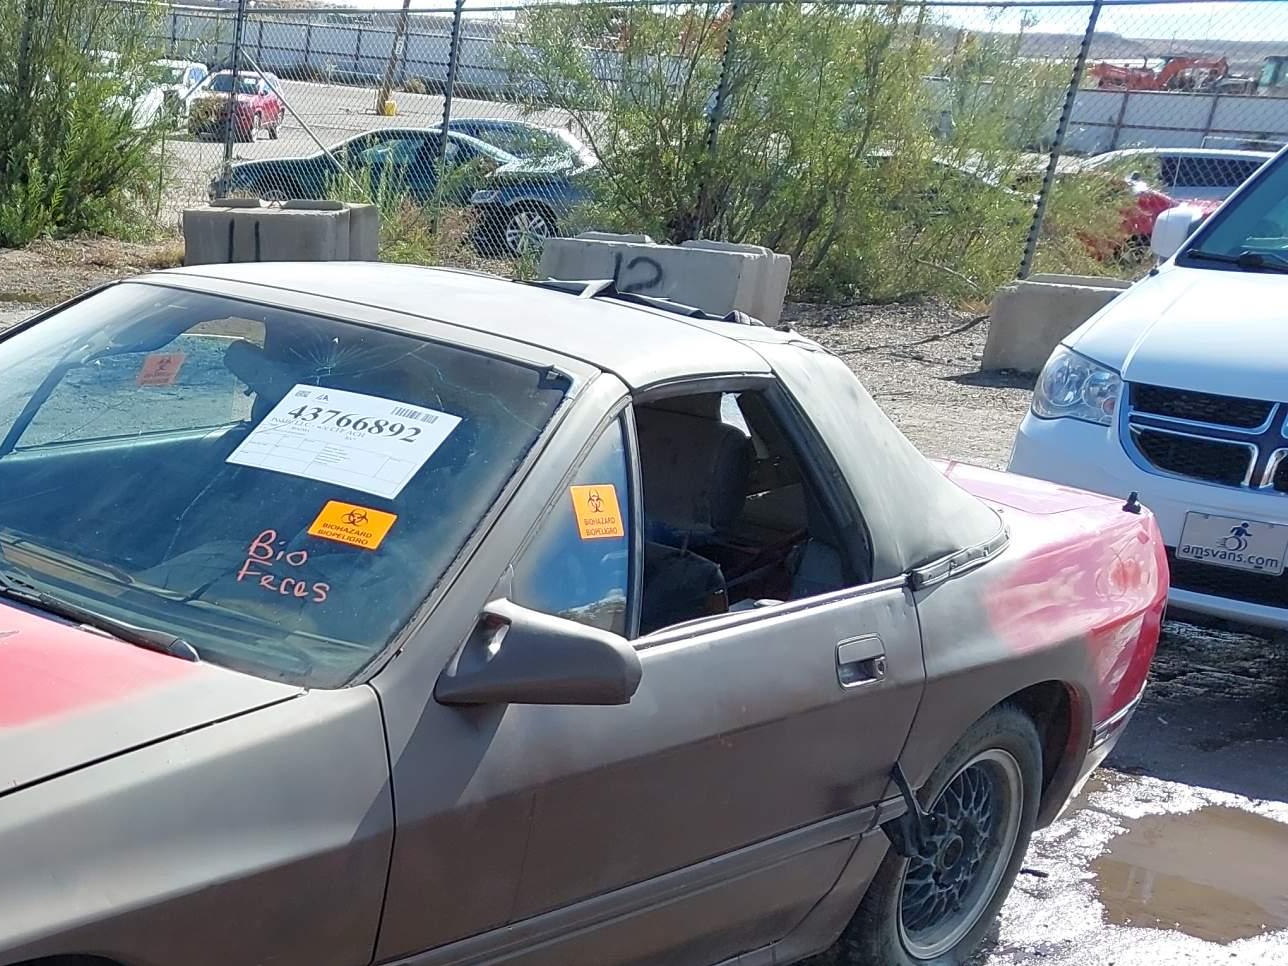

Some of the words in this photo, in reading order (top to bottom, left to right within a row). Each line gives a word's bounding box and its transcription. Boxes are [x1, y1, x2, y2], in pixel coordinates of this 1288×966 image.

[613, 252, 664, 292] 12
[288, 405, 422, 444] 43766892
[317, 528, 369, 546] BIOPELIGRO
[322, 522, 373, 539] BIOHAZARD
[249, 530, 307, 565] Bio
[1182, 544, 1279, 569] amsvans.com
